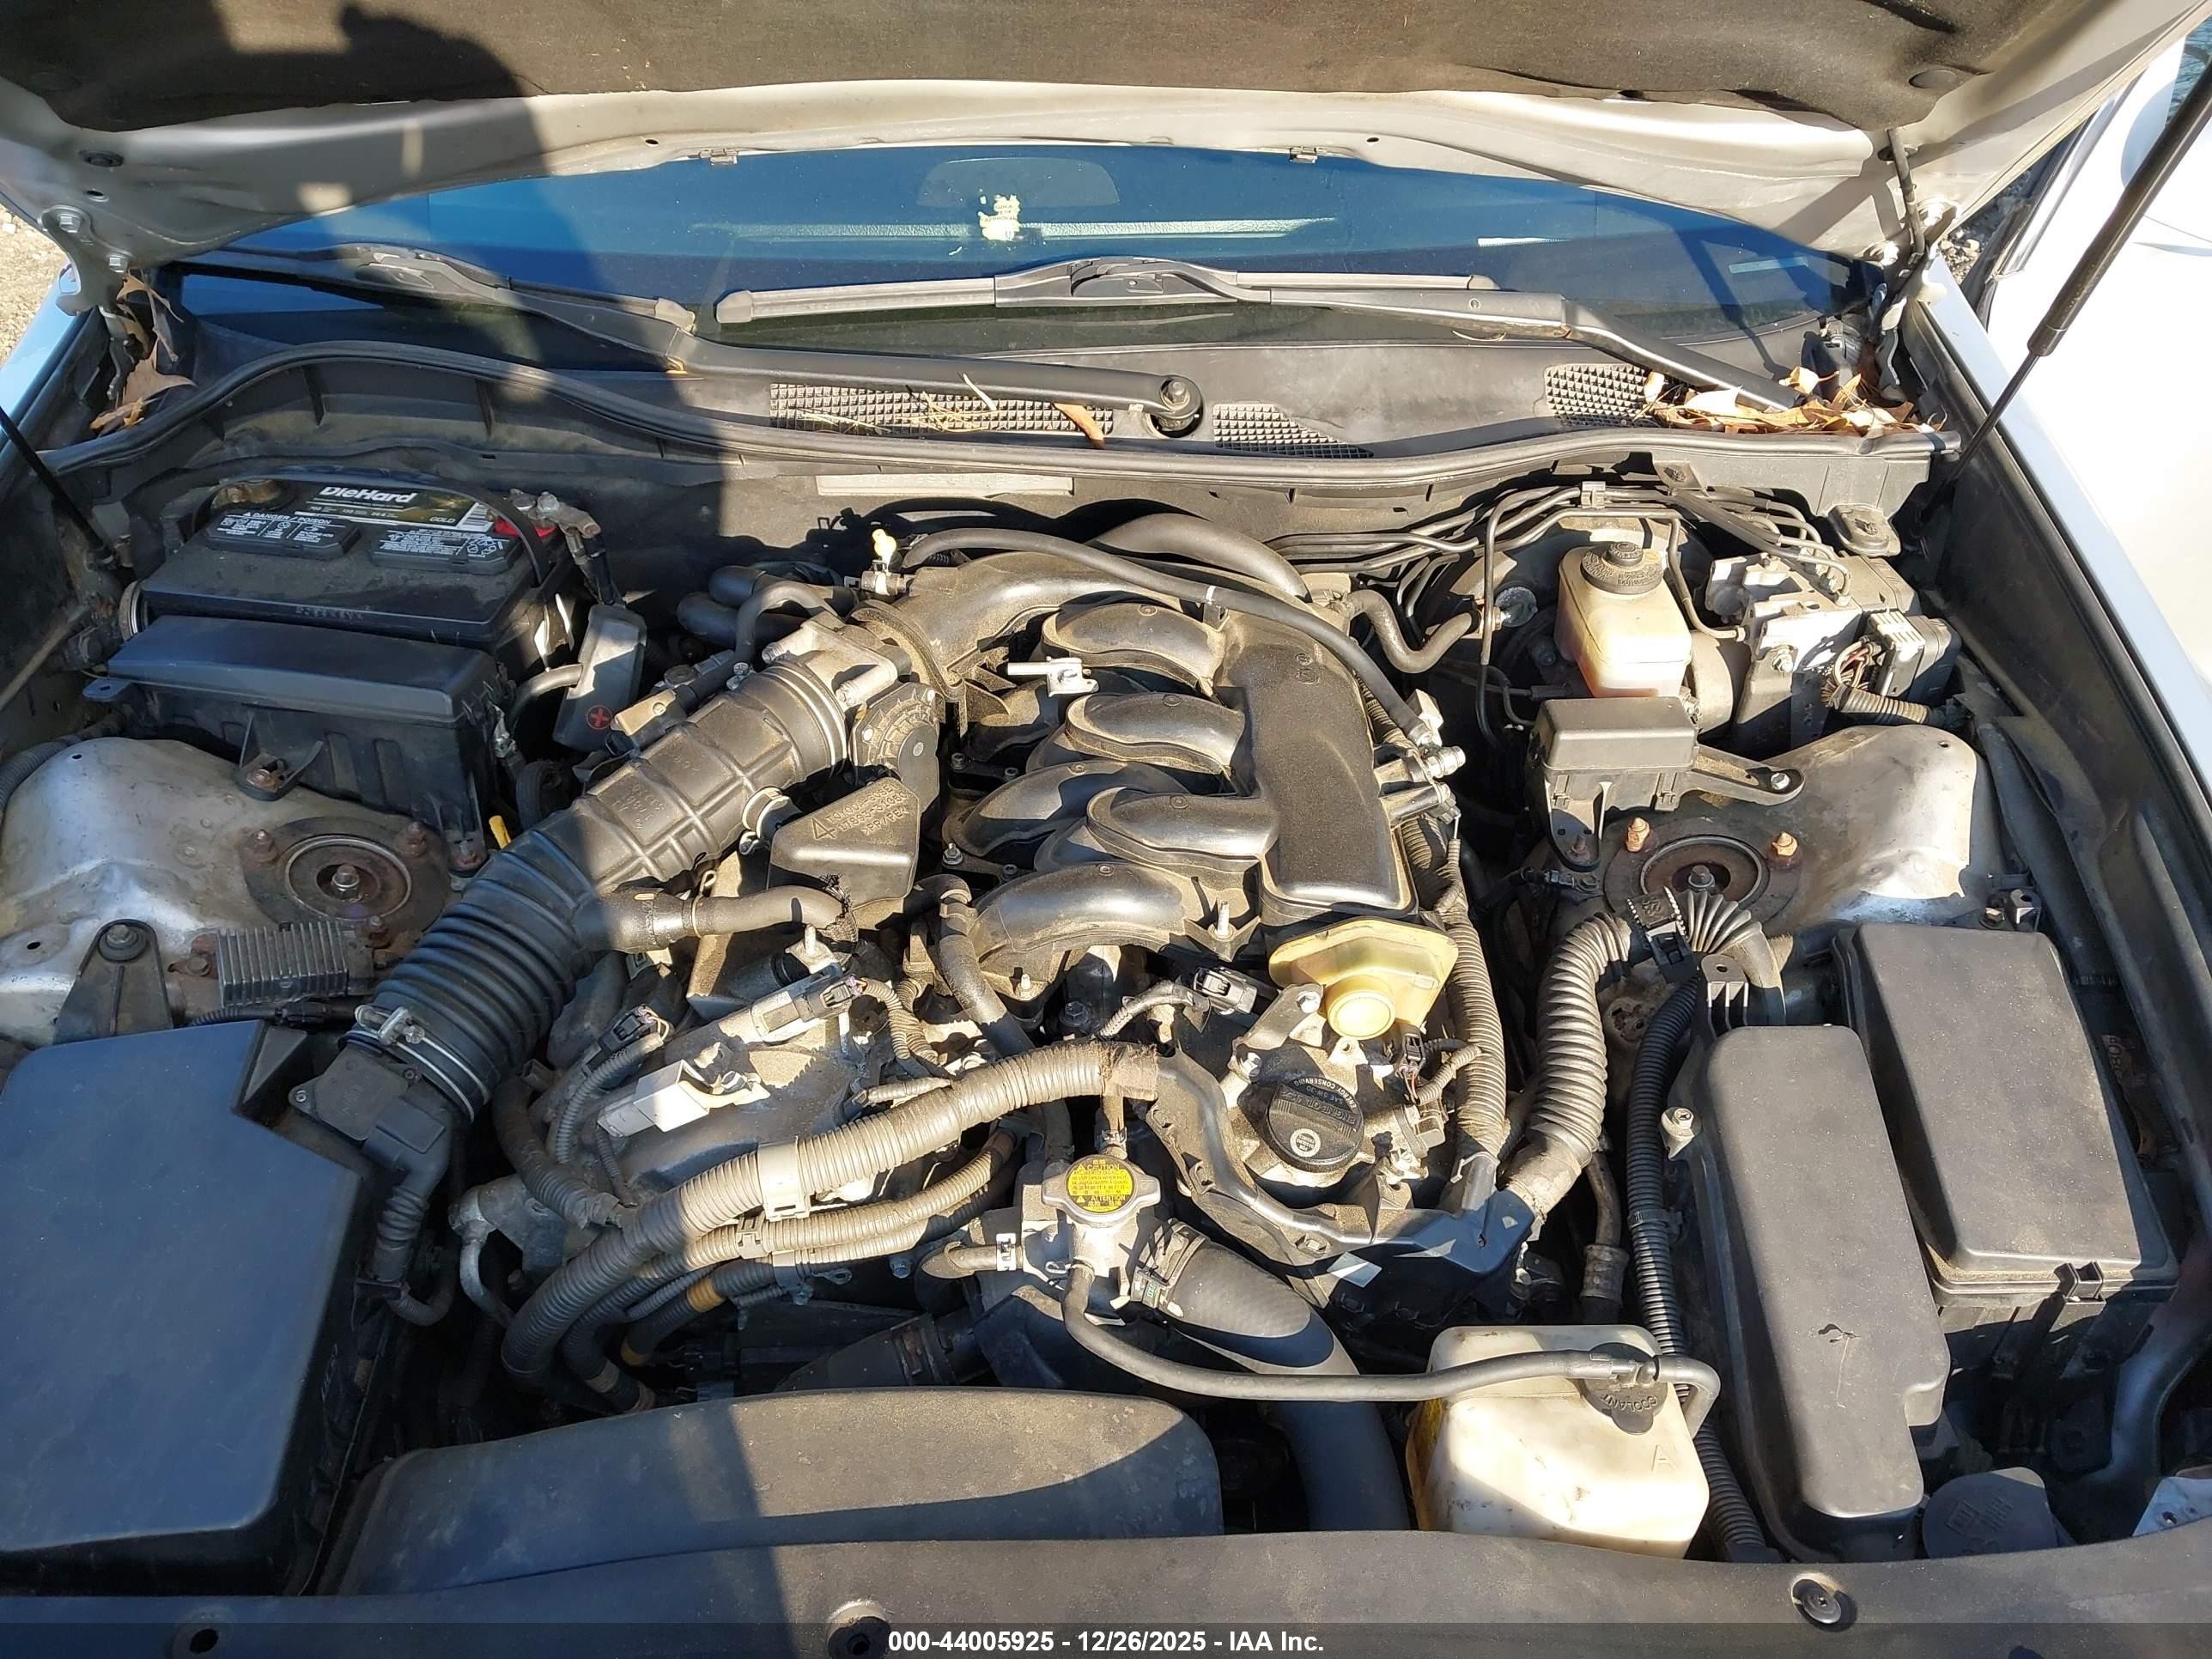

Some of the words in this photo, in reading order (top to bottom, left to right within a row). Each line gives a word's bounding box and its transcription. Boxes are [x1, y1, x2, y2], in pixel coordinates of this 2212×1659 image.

[319, 486, 417, 503] DieHard
[252, 512, 291, 521] DANGER
[298, 516, 332, 525] POISON
[1321, 1104, 1357, 1125] ENGINE
